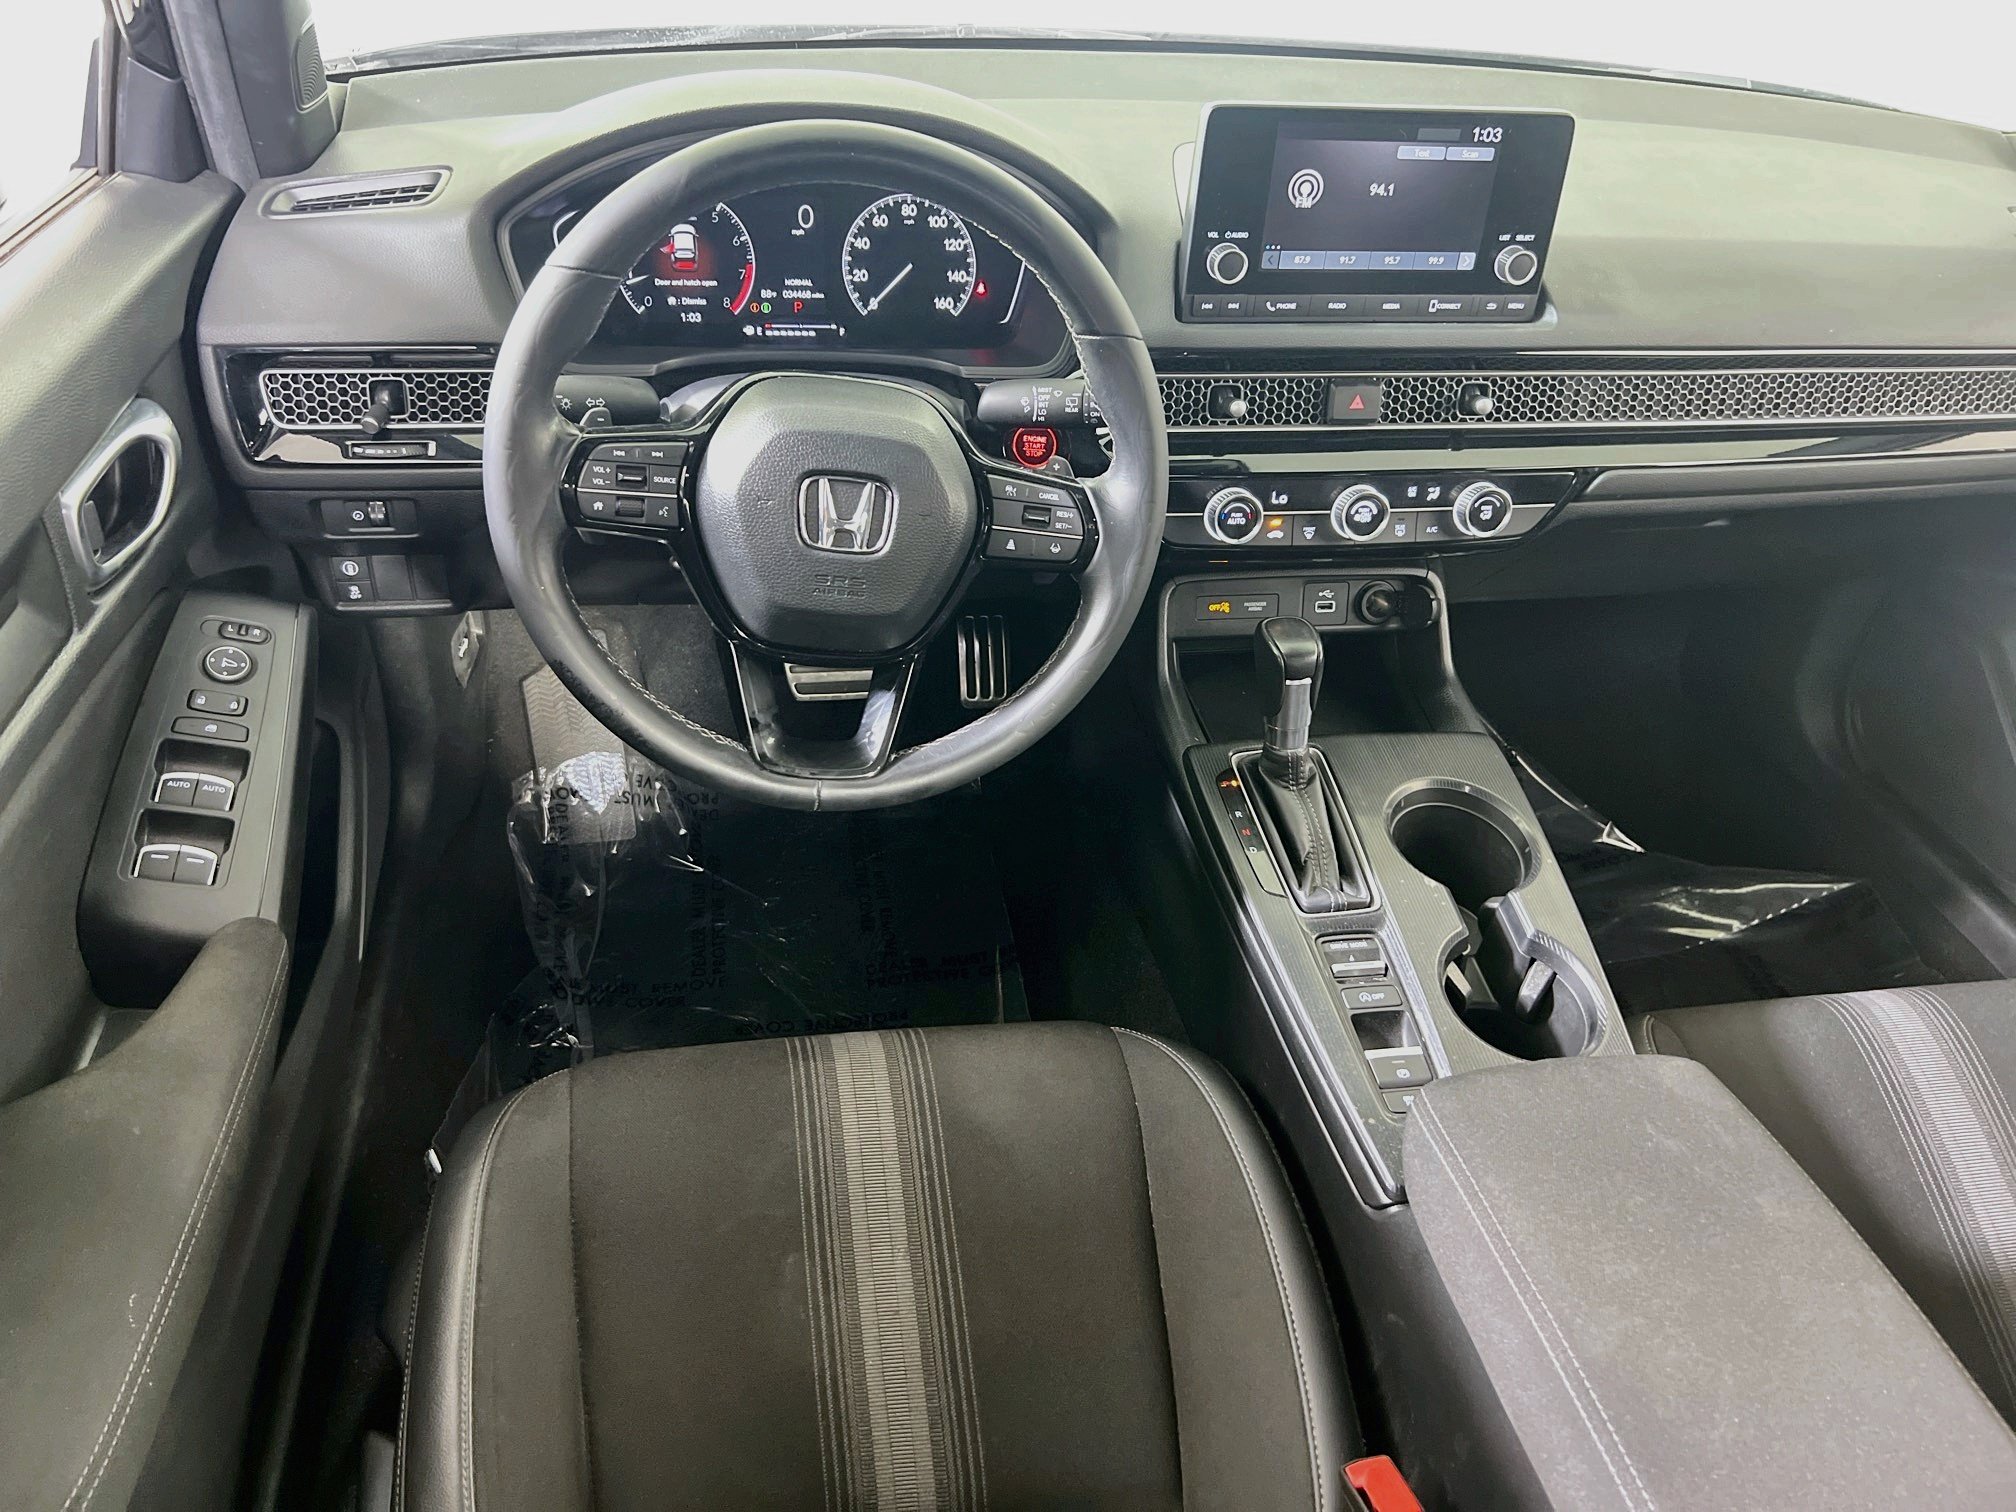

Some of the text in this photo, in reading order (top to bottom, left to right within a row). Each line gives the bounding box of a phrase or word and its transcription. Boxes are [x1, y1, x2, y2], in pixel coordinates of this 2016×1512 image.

[1472, 127, 1502, 143] 1:03
[1461, 150, 1479, 159] Scan
[1369, 182, 1395, 197] 94.1
[1295, 197, 1312, 209] FM
[901, 204, 917, 217] 80
[711, 212, 719, 223] 5
[797, 204, 814, 229] 0
[872, 215, 888, 227] 60
[928, 215, 948, 228] 100
[1207, 231, 1219, 239] VOL
[1515, 234, 1536, 242] SELECT
[732, 236, 740, 246] 6
[854, 237, 870, 250] 40
[944, 238, 963, 251] 120
[1293, 256, 1311, 265] 87.9
[1427, 257, 1445, 265] 99.9
[738, 269, 746, 280] 7
[853, 269, 869, 282] 20
[947, 270, 967, 283] 140
[655, 278, 718, 289] Door and hatch open
[784, 278, 813, 287] NORMAL
[782, 290, 811, 299] 034468
[644, 296, 652, 307] 0
[723, 298, 731, 308] 8
[934, 297, 954, 310] 160
[1327, 302, 1347, 310] RADIO
[1382, 302, 1400, 310] MEDIA
[793, 301, 803, 313] P
[1275, 302, 1297, 311] PHONE
[1507, 303, 1525, 311] MENU
[680, 312, 702, 323] 1:03
[1022, 435, 1047, 444] ENGINE
[1024, 442, 1046, 450] START
[1025, 450, 1043, 458] STOP
[653, 476, 677, 484] SOURCE
[1038, 492, 1060, 501] CANCEL
[1271, 490, 1288, 505] Lo
[1226, 517, 1247, 525] AUTO
[1425, 525, 1439, 533] A/C
[814, 574, 866, 588] SRS
[812, 587, 865, 598] AIRBAG
[1208, 603, 1221, 611] OFF
[228, 624, 234, 632] L
[253, 628, 261, 636] R
[166, 779, 191, 789] AUTO
[202, 784, 226, 794] AUTO
[1234, 810, 1243, 818] R
[1241, 828, 1251, 836] N
[1248, 846, 1257, 854] D
[1371, 992, 1385, 1001] OFF
